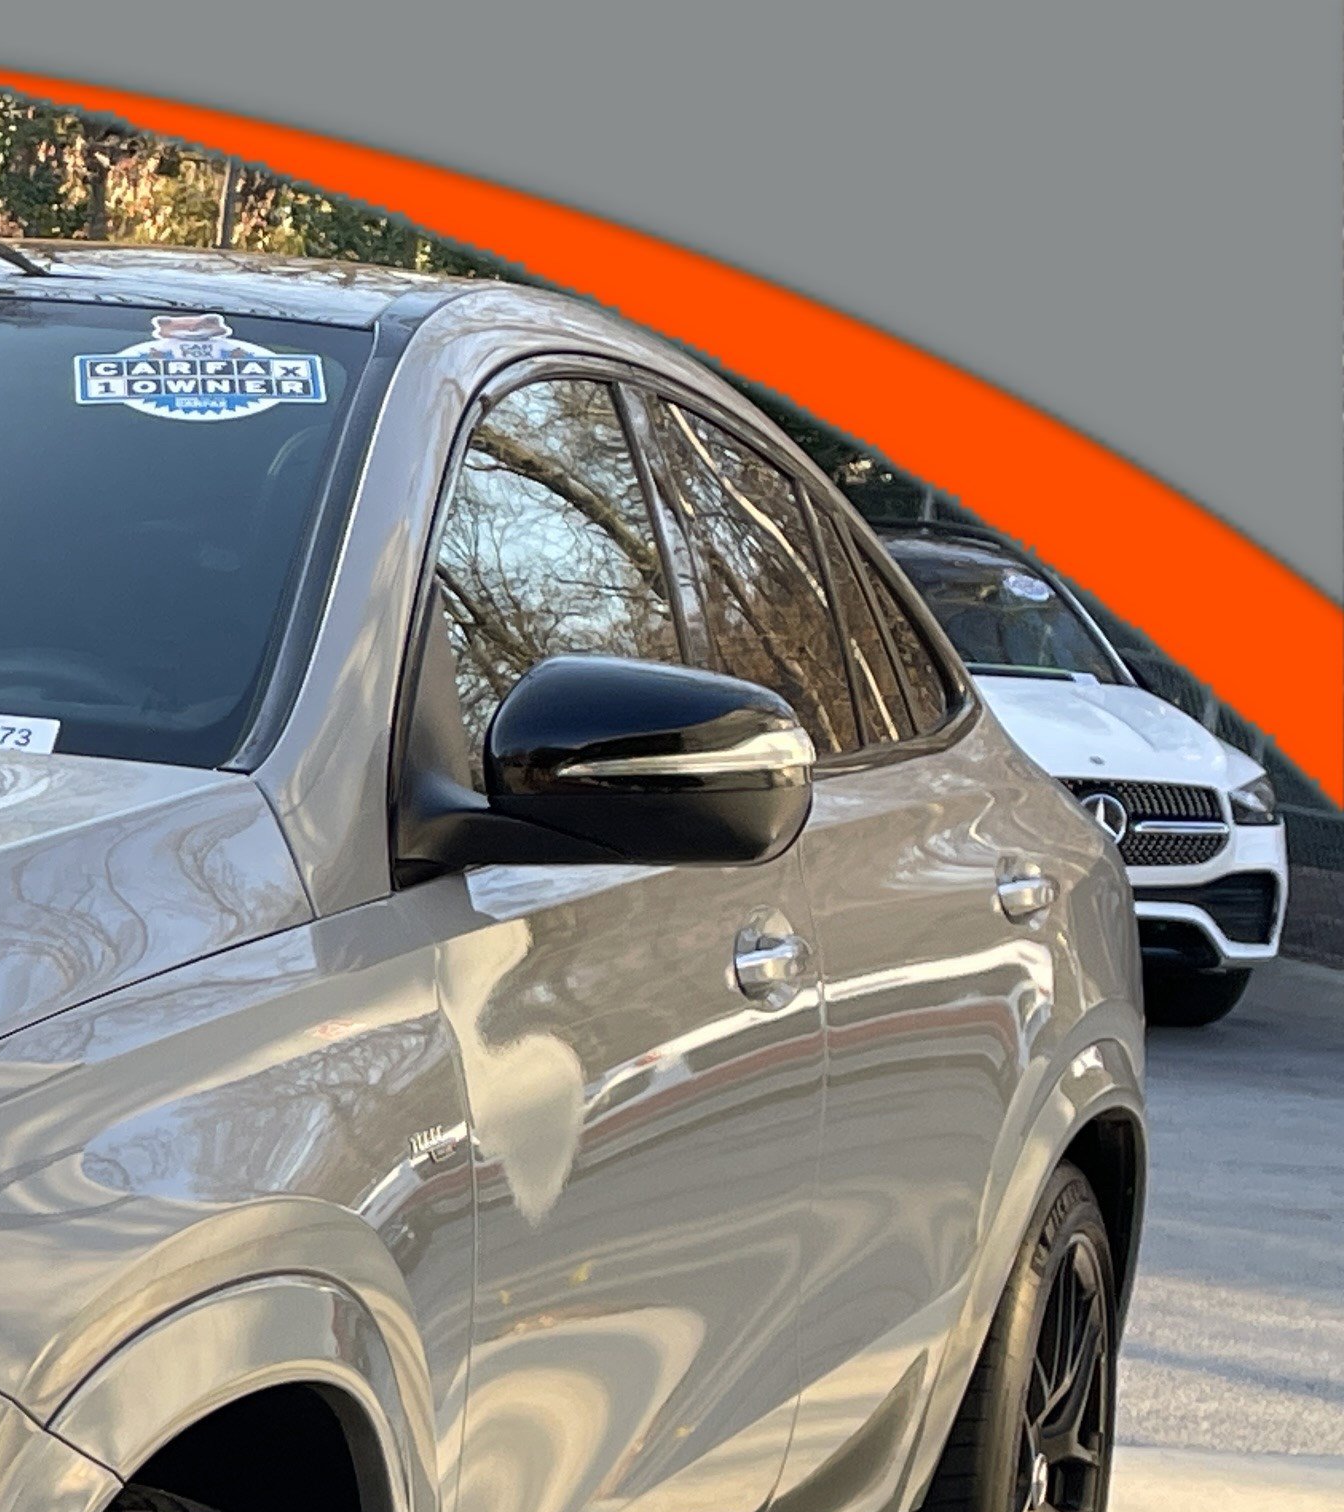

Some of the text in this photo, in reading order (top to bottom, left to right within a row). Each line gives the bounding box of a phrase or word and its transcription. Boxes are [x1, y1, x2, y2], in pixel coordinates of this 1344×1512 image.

[94, 360, 303, 378] CARFAX
[97, 379, 304, 395] 1 OWNER
